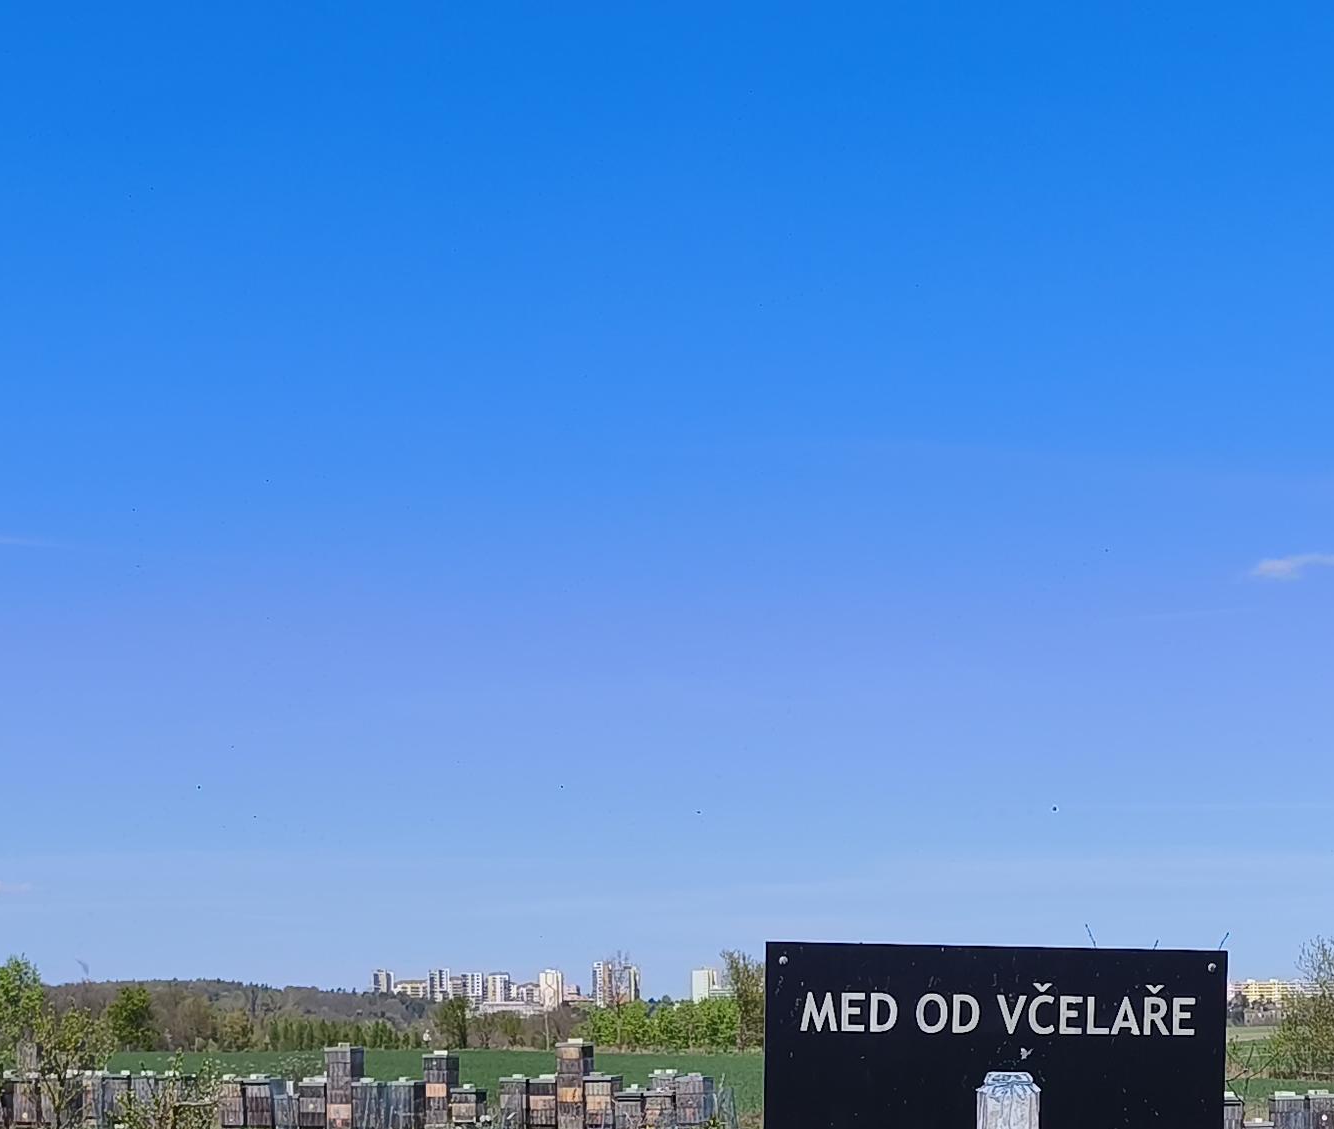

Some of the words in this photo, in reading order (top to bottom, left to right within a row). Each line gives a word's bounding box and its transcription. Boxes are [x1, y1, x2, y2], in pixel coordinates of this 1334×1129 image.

[800, 991, 898, 1033] MED
[915, 993, 980, 1034] OD
[996, 983, 1196, 1036] VČELAŘE
